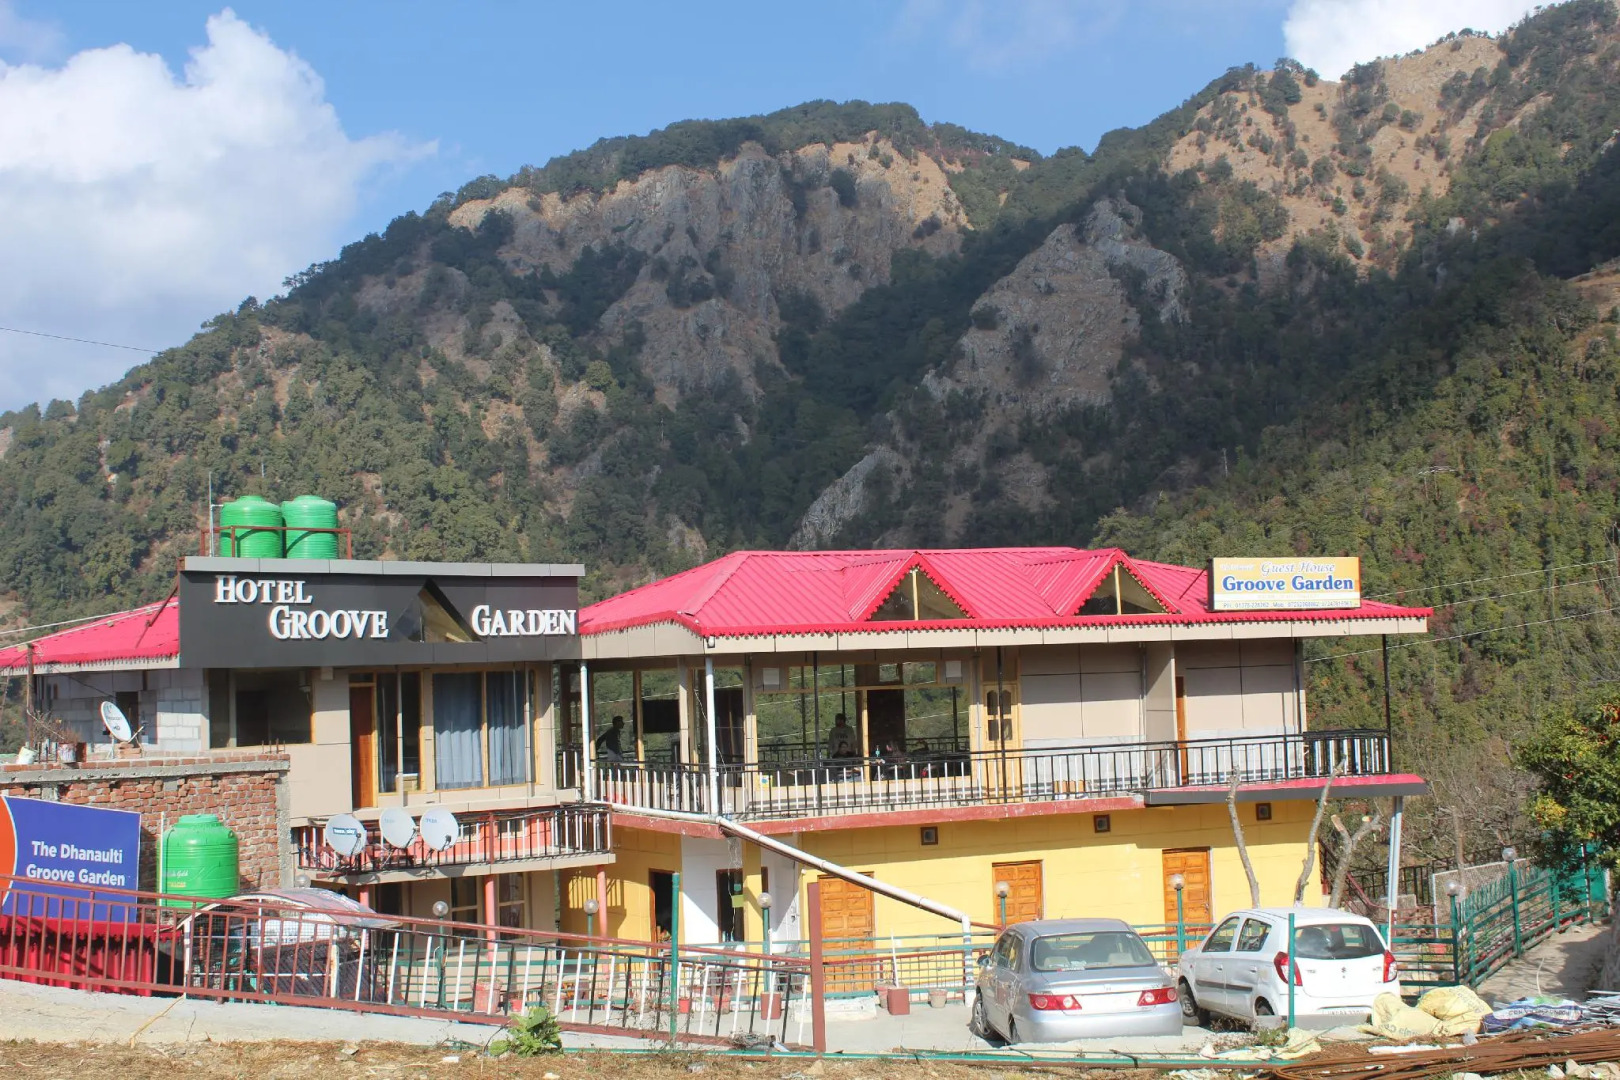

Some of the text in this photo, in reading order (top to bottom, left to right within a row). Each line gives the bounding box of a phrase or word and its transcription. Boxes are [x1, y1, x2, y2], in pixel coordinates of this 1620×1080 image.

[1261, 560, 1295, 577] Guest
[1298, 560, 1336, 573] House
[214, 575, 313, 604] HOTEL
[1222, 575, 1354, 591] Groove Garden
[269, 604, 577, 640] GROOVE GARDEN
[31, 841, 123, 864] The Dhanaulti
[26, 864, 125, 887] Groove Garden
